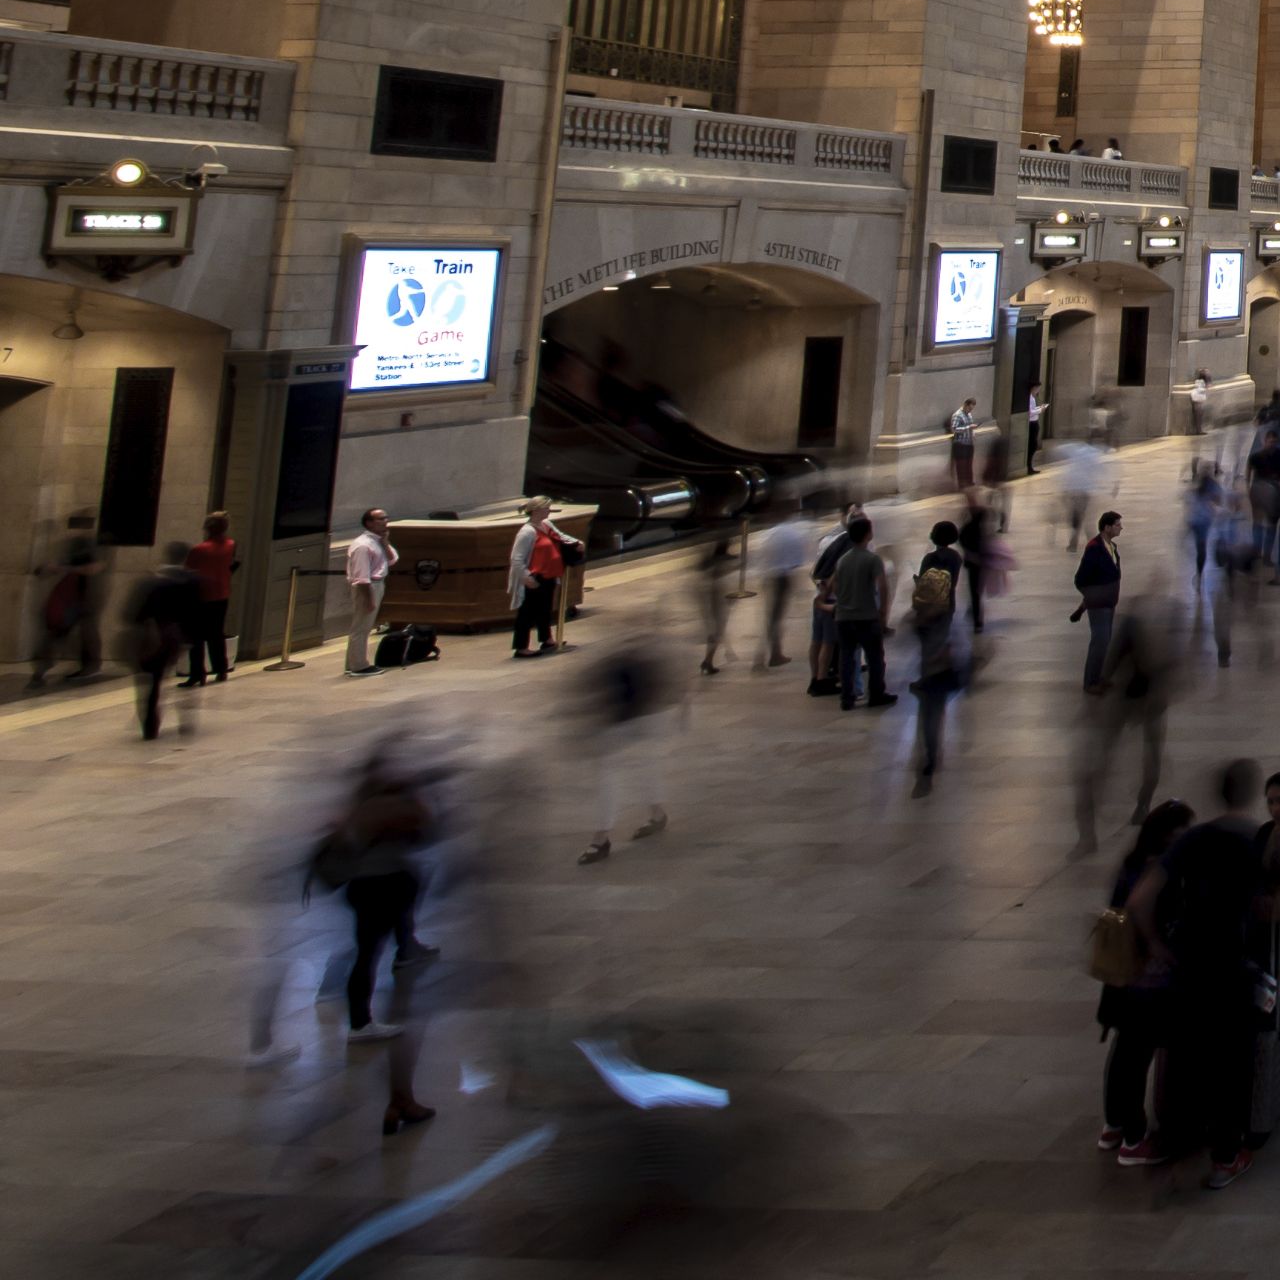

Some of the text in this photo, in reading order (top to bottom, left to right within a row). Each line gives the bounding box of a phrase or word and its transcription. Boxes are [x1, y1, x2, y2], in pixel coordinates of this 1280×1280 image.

[84, 215, 141, 228] TRACK
[763, 241, 843, 272] 45TH STREET
[387, 258, 474, 275] Take Train
[543, 239, 720, 305] THE METLIFE BUILDING
[417, 330, 465, 346] Game
